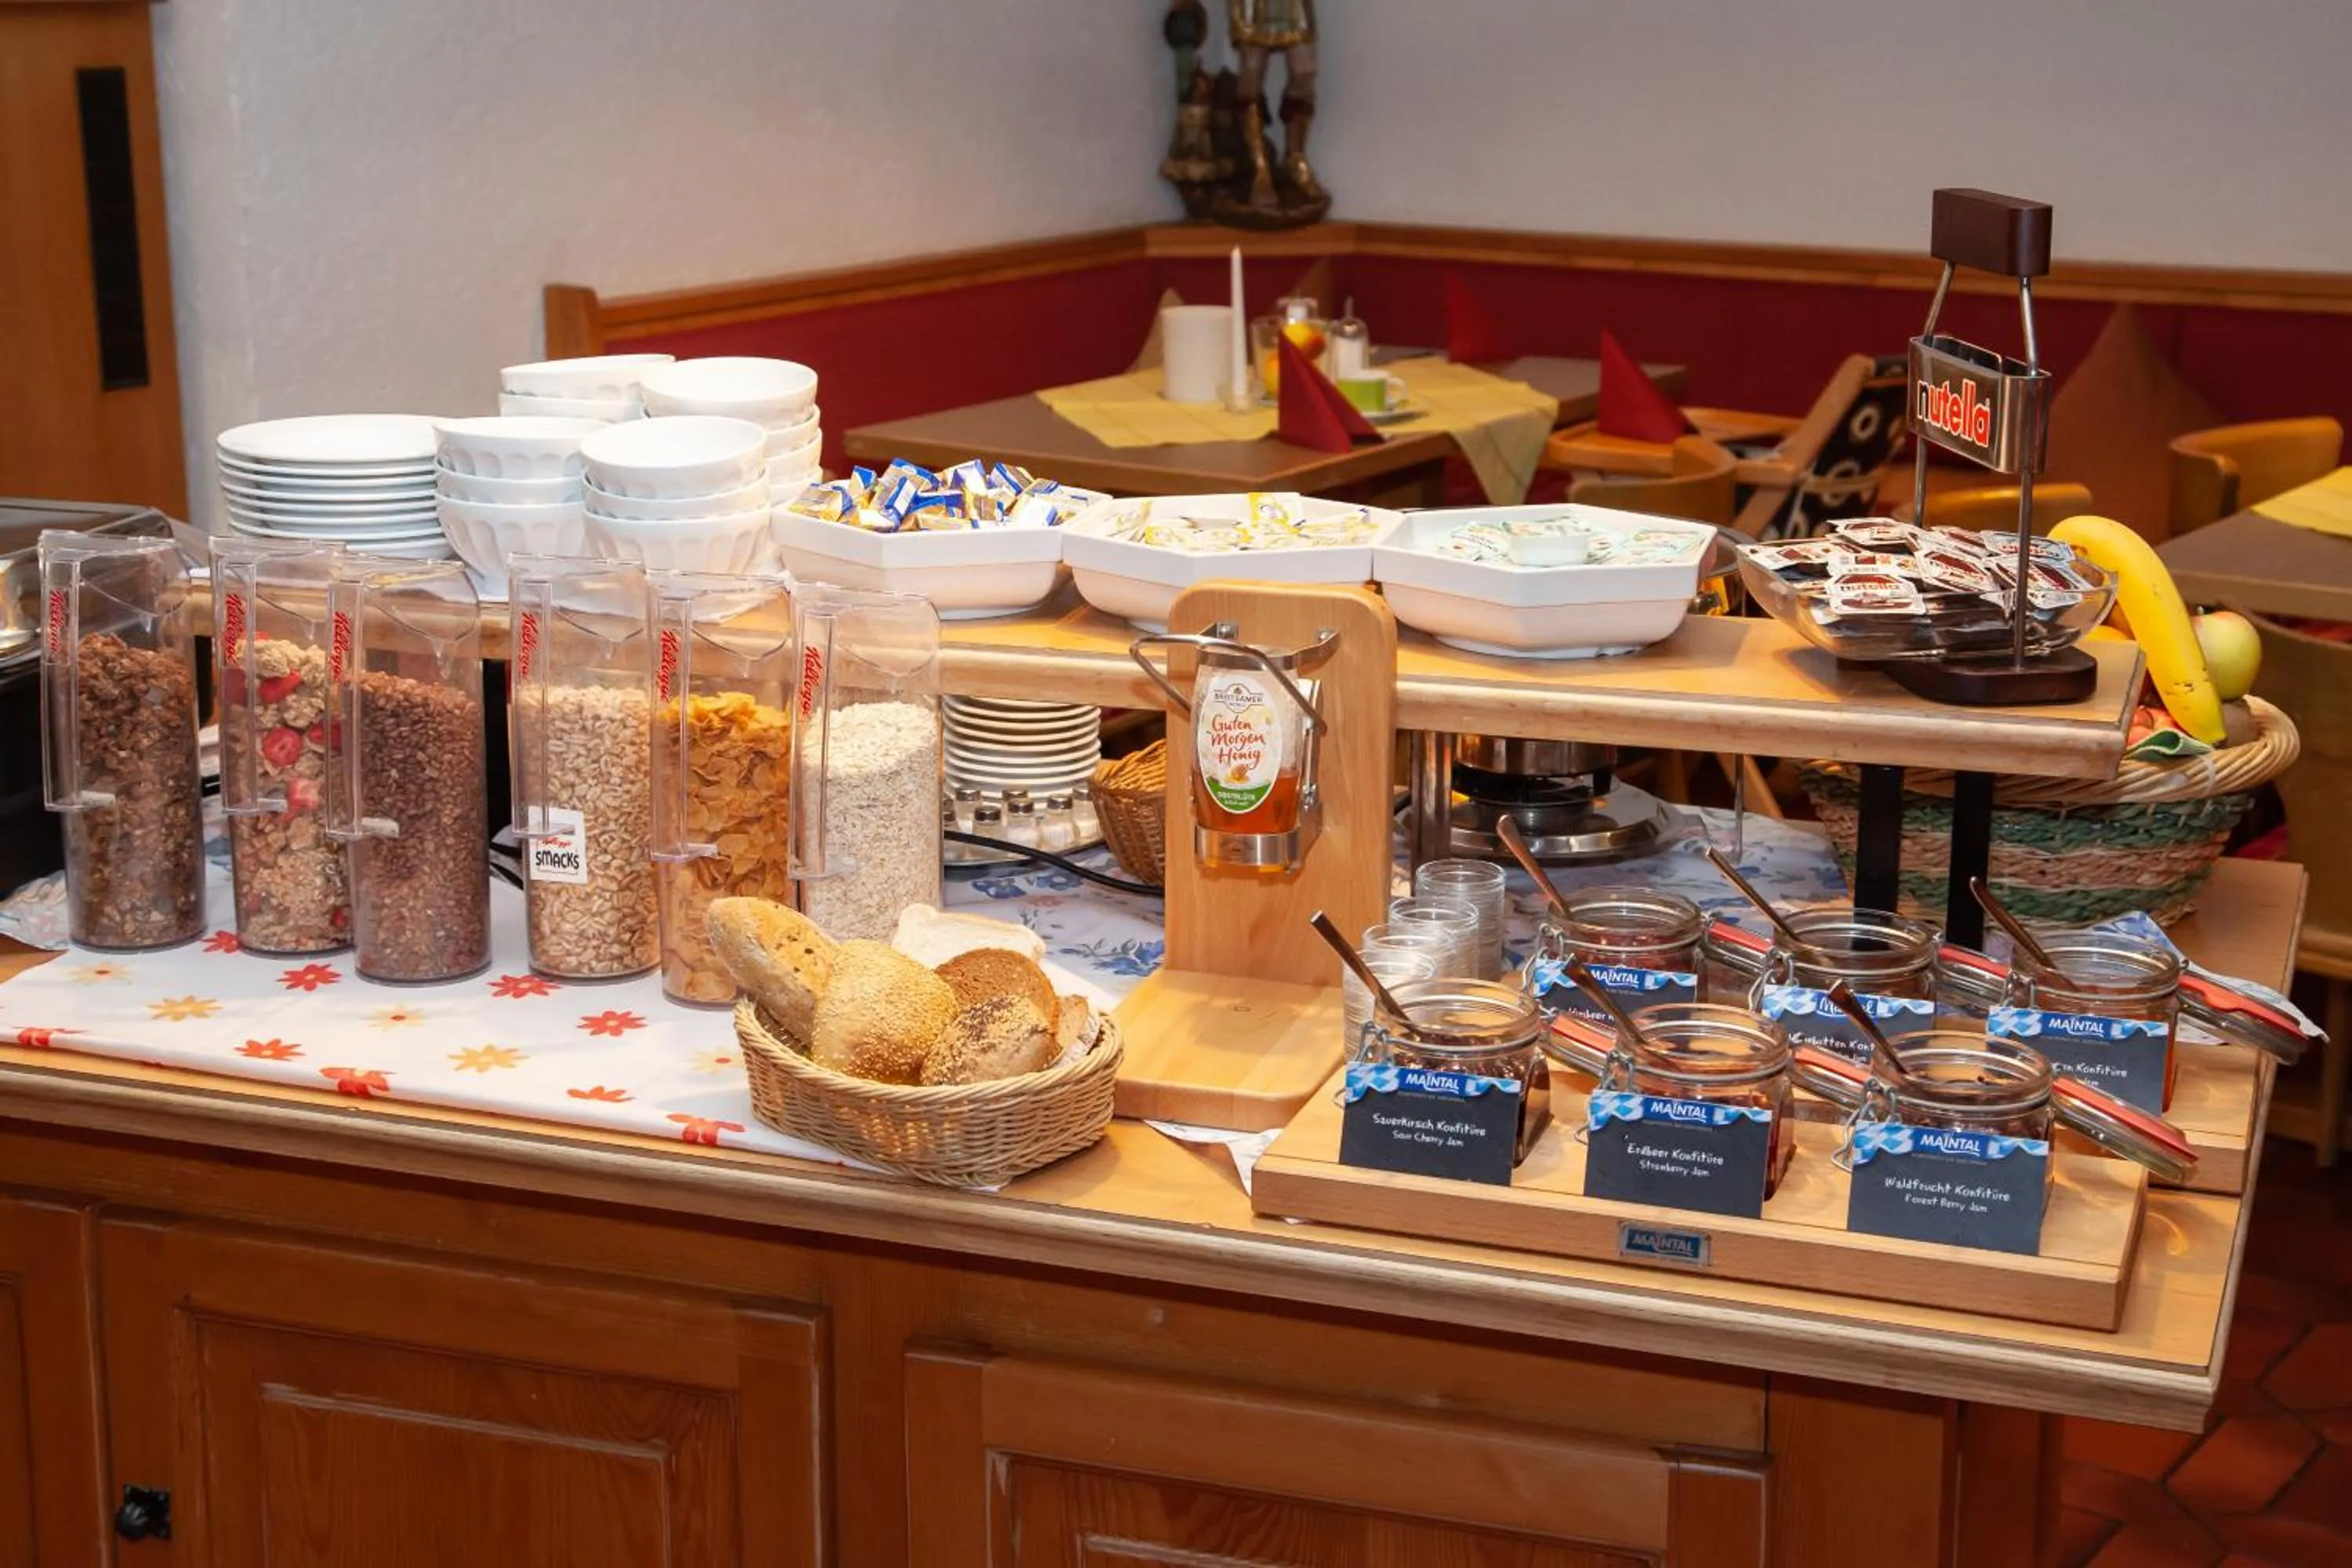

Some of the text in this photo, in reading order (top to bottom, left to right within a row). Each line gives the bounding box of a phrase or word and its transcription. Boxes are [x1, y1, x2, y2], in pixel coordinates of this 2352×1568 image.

[1916, 379, 1991, 448] nutella
[1211, 714, 1252, 731] Guten
[1209, 731, 1265, 751] Morgen
[1218, 747, 1261, 769] Honig
[1372, 1112, 1486, 1136] Sauerkirsch Konfitüre
[1414, 1132, 1443, 1146] Cherry
[1446, 1137, 1464, 1146] Jam
[1628, 1142, 1724, 1166] Erdbeer Konfitüre
[1691, 1167, 1709, 1176] Jam
[1886, 1178, 2010, 1202] Waldfrucht Konfitüre
[1905, 1194, 1987, 1213] Forest Berry Jam
